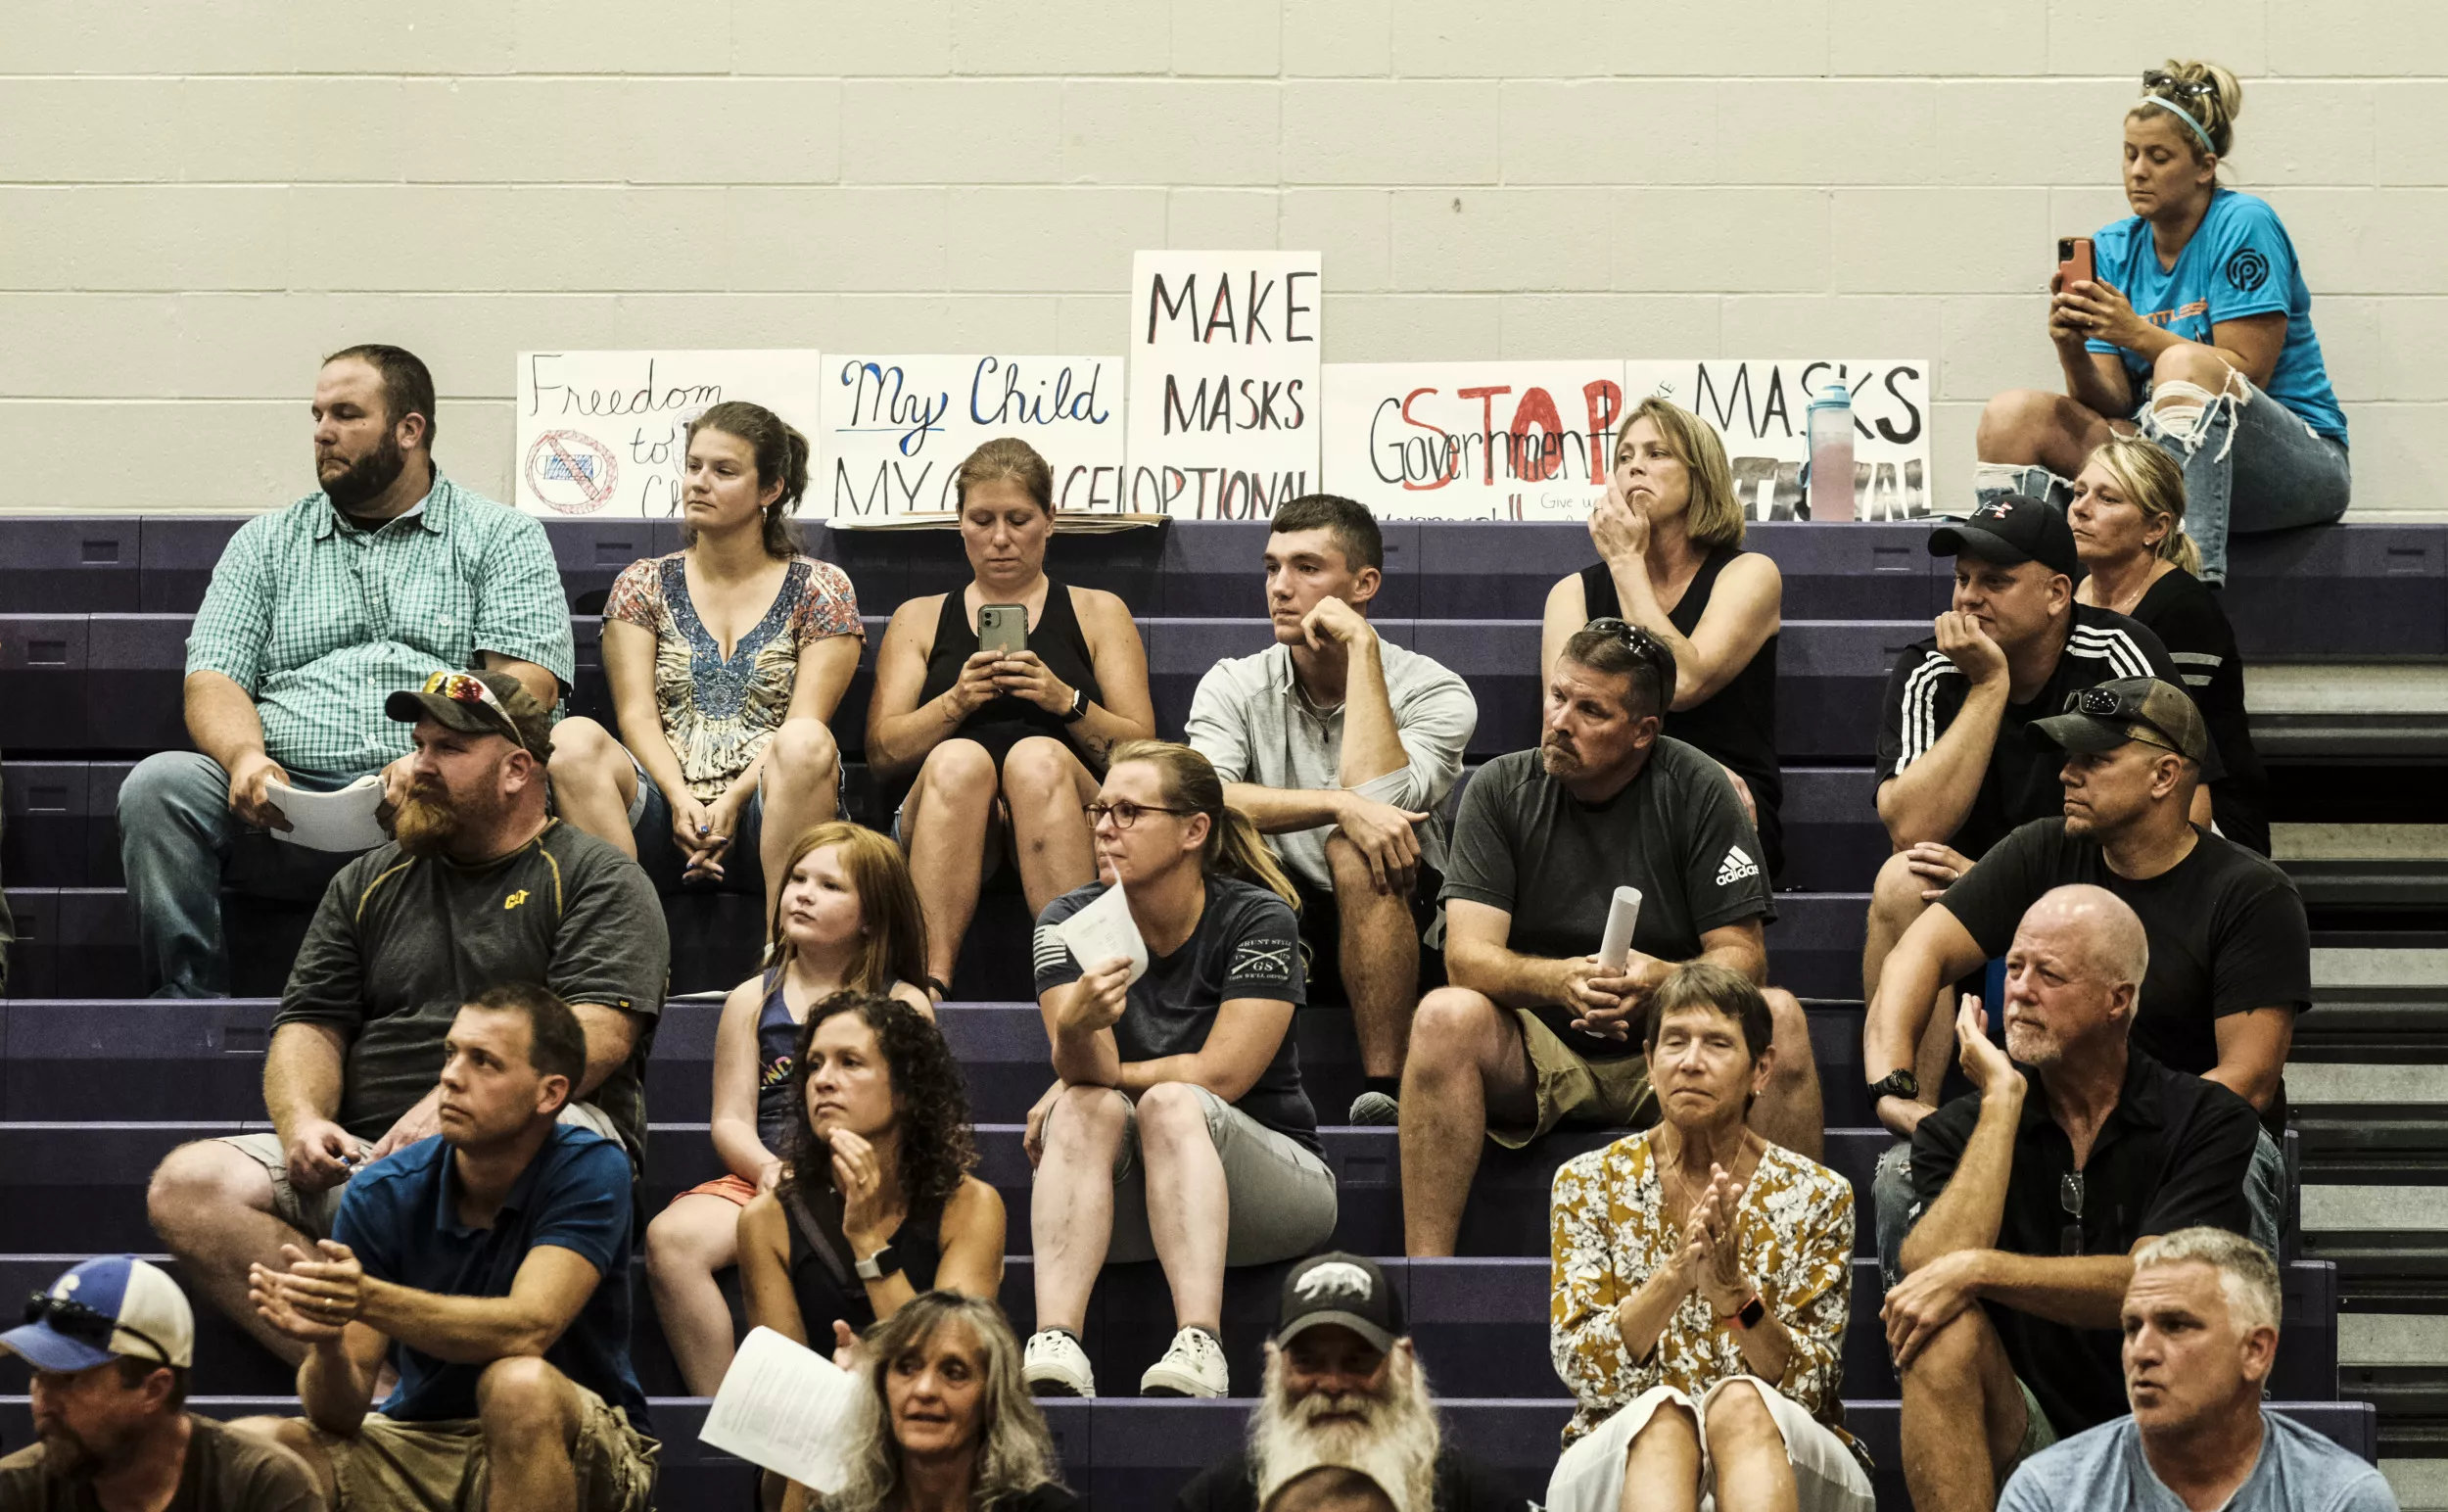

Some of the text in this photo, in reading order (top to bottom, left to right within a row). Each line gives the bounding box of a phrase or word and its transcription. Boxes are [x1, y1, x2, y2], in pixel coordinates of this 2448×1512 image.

[1147, 270, 1318, 346] MAKE
[529, 354, 722, 416] Freedom
[841, 356, 1109, 456] My Child
[1163, 373, 1305, 436] MASKS
[630, 427, 675, 464] to
[1370, 385, 1619, 484] Government
[1402, 379, 1623, 491] STOP
[834, 456, 933, 517] MY
[1540, 492, 1574, 509] Give
[1716, 864, 1760, 886] adidas
[1253, 962, 1273, 971] GS
